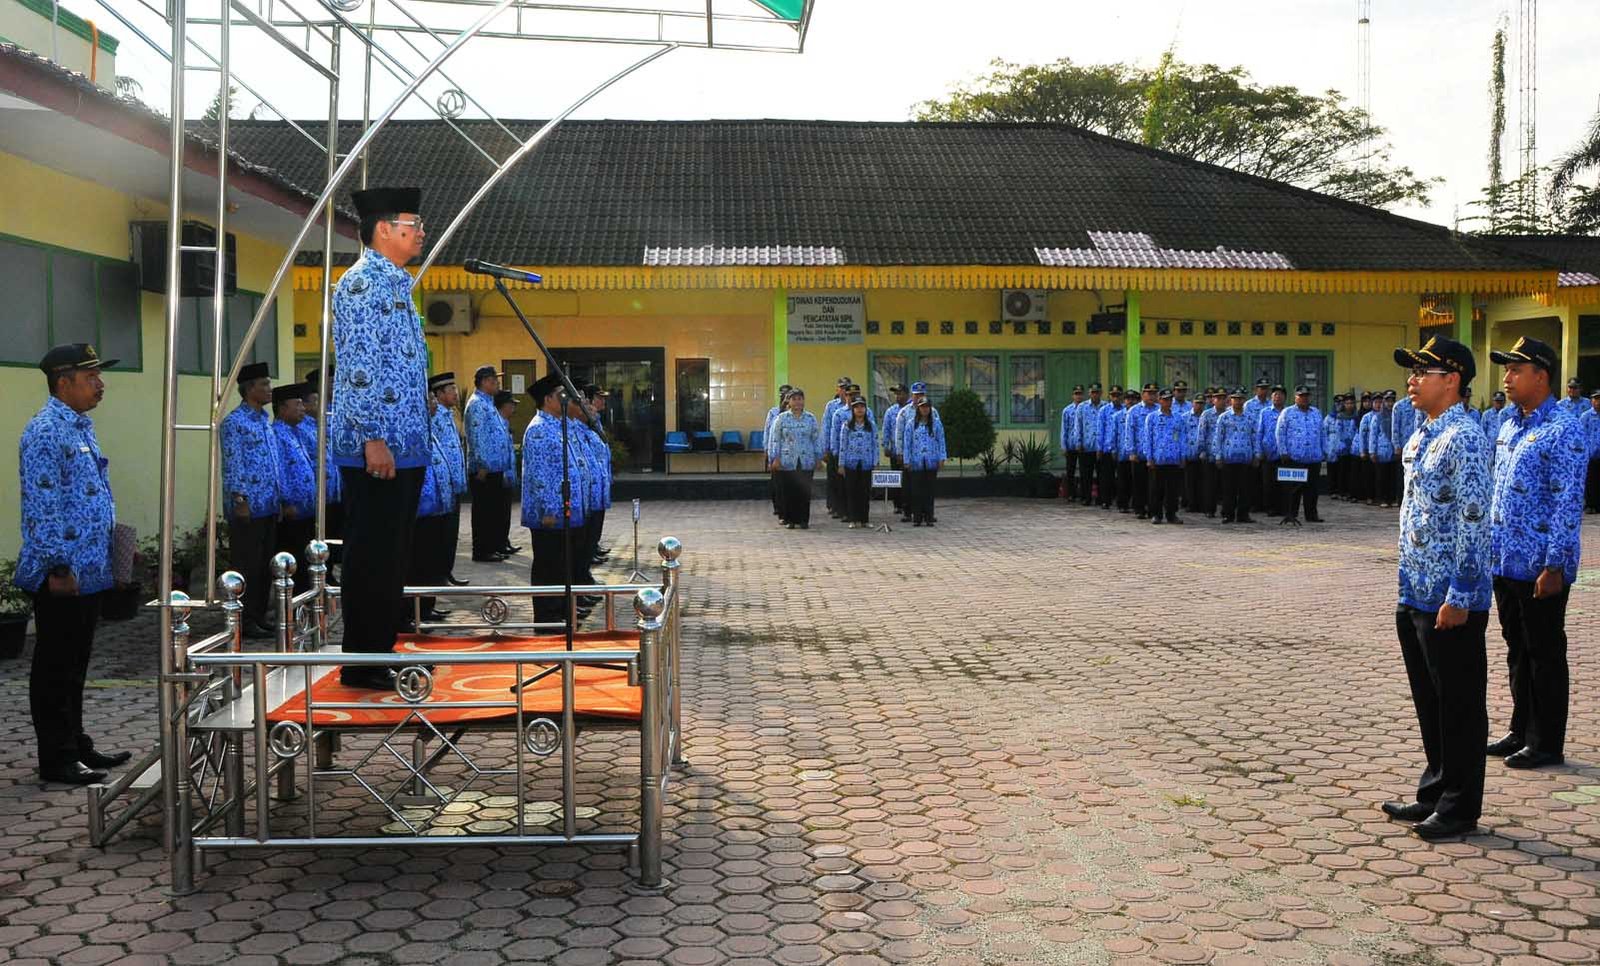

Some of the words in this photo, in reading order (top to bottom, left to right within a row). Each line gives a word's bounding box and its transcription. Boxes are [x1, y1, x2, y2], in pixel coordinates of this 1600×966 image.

[796, 296, 813, 304] DINAS
[814, 296, 861, 304] KEPENDUDUKAN
[803, 314, 839, 322] PENCATATAN
